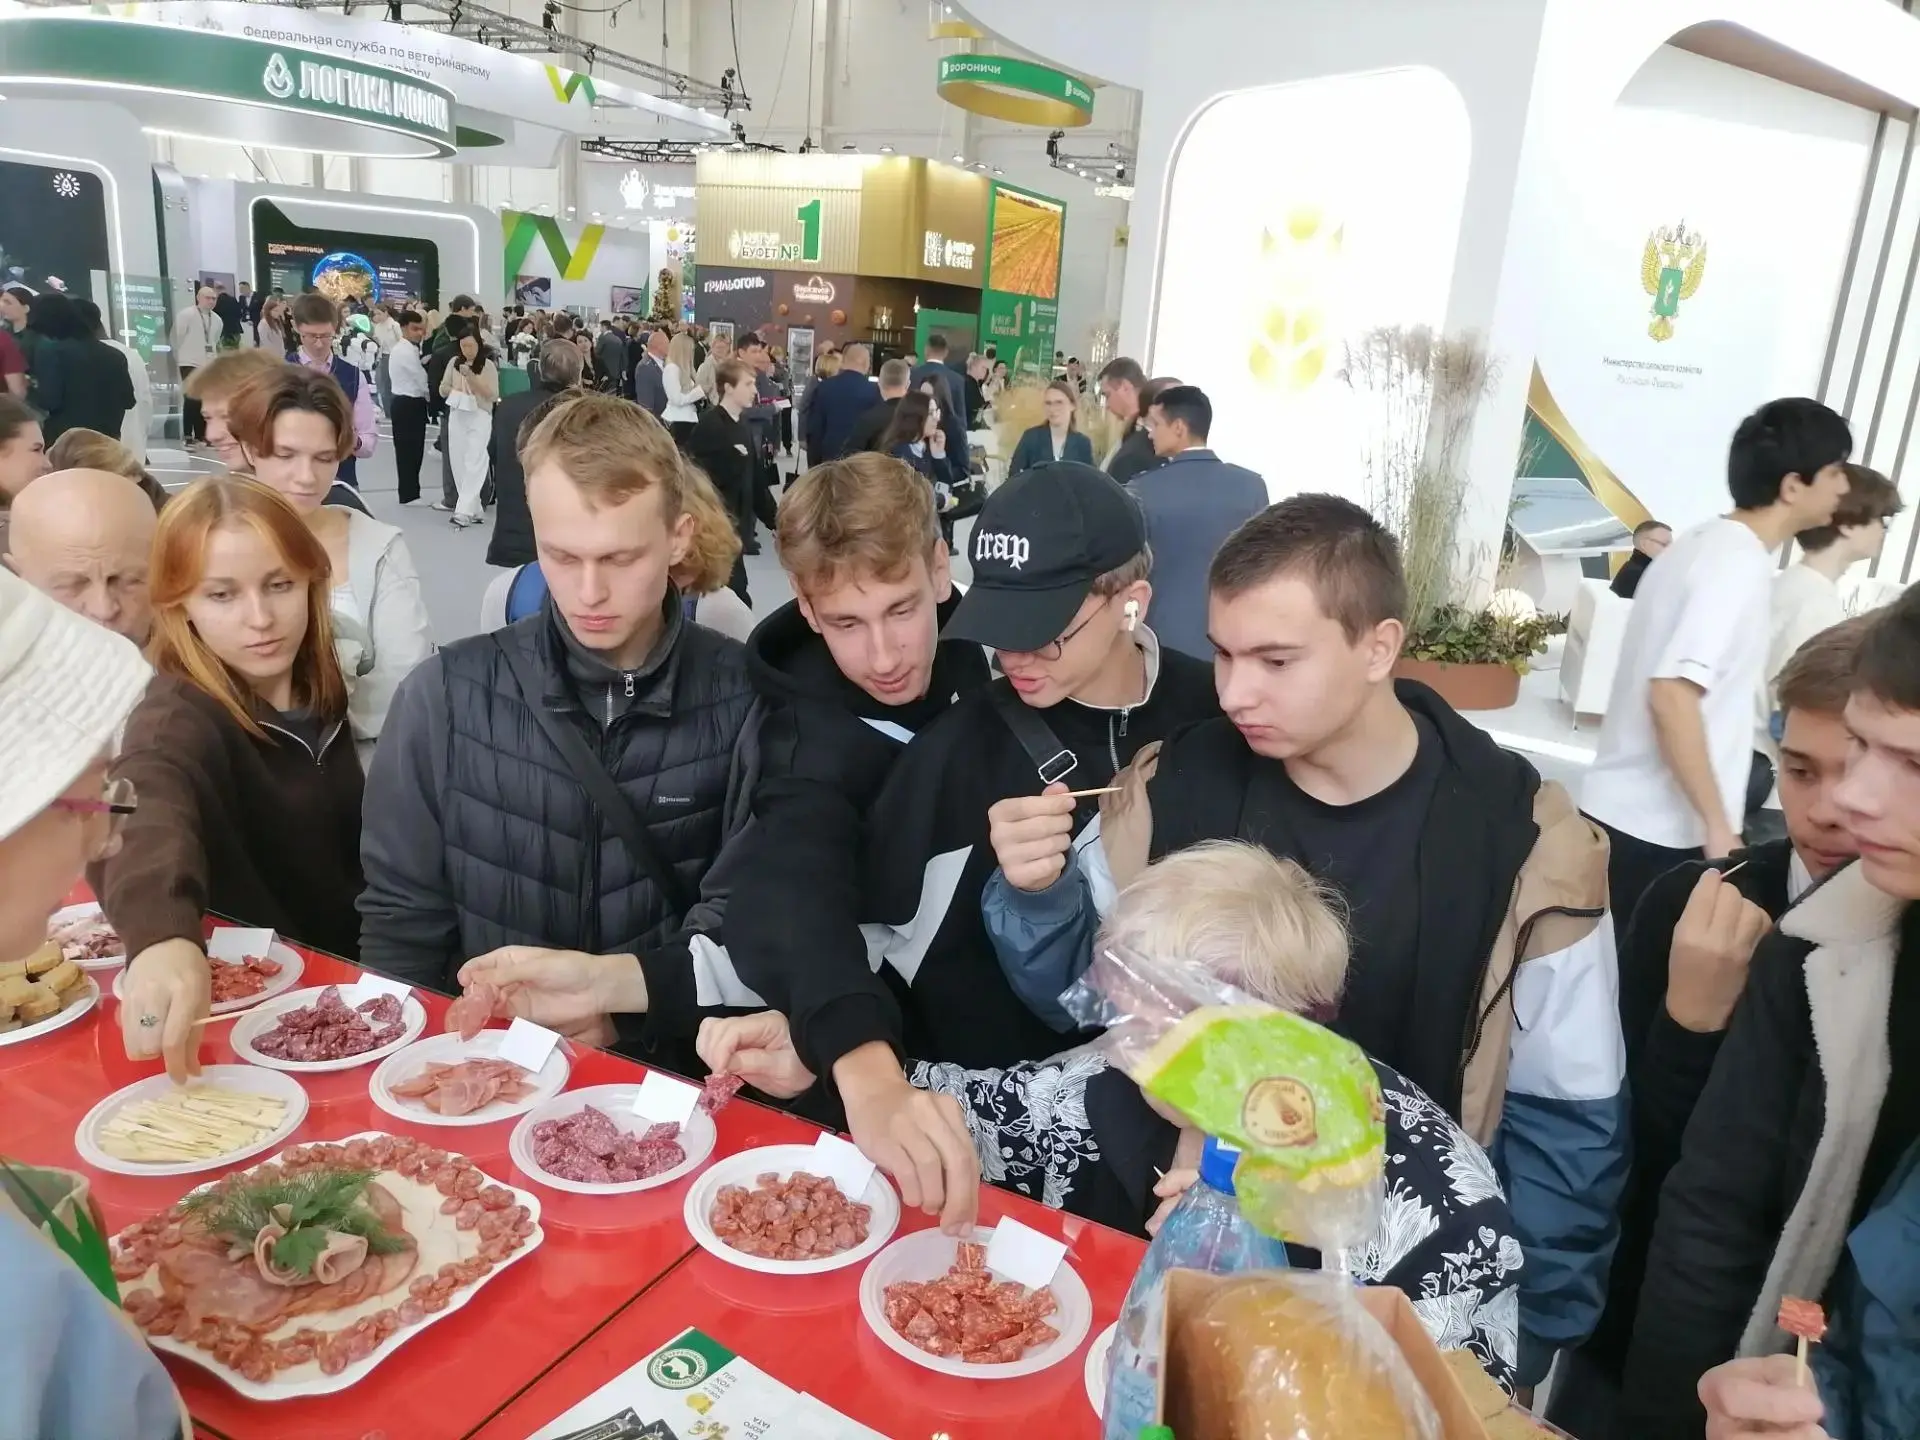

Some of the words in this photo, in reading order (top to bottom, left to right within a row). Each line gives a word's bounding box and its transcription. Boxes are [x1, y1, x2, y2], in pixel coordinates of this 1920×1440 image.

[243, 25, 333, 47] Федеральная
[336, 38, 387, 56] служба
[389, 45, 405, 59] по
[407, 49, 492, 81] ветеринарному
[299, 60, 393, 116] ЛОГИКА
[975, 528, 1030, 571] trap
